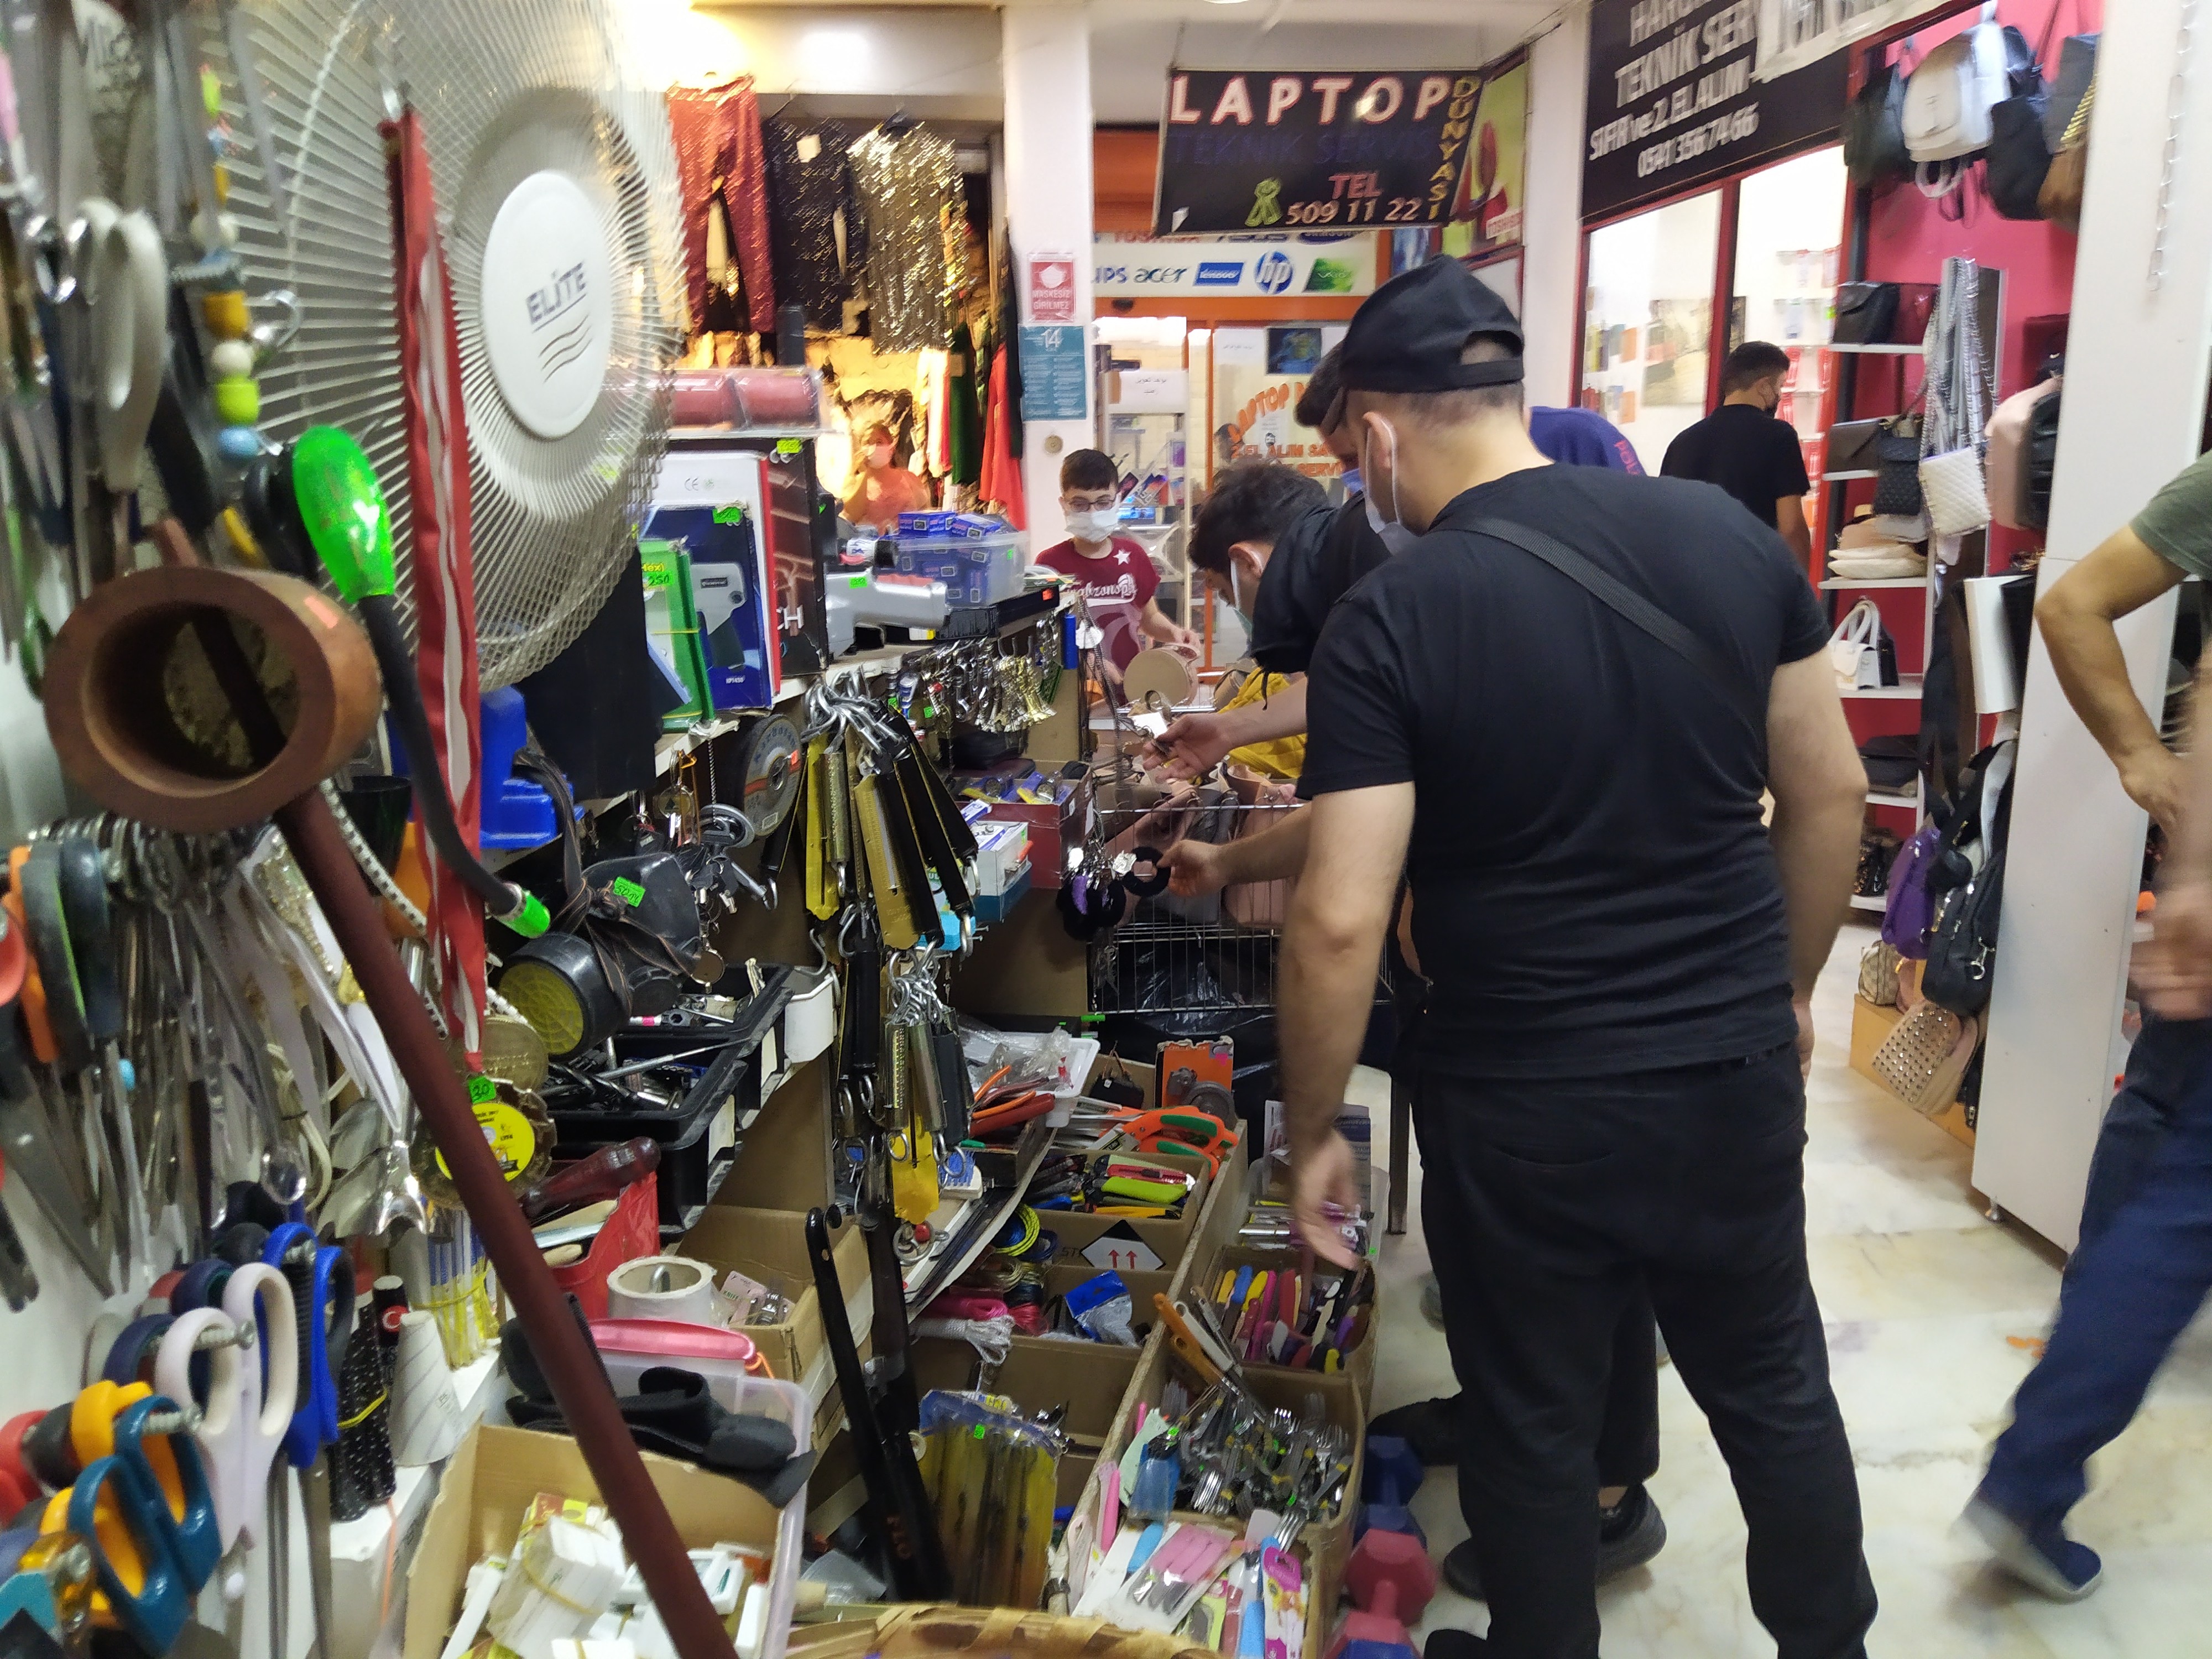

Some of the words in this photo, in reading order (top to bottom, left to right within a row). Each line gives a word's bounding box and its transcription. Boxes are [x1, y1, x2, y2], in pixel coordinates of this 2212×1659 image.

[1699, 0, 1757, 65] SER
[1168, 75, 1452, 125] LAPTOP
[1328, 171, 1382, 200] TEL
[1285, 199, 1338, 226] 509
[1347, 198, 1378, 222] 11
[1385, 197, 1424, 222] 22
[1132, 265, 1189, 284] acer
[1254, 250, 1294, 295] hp
[1227, 383, 1290, 444] LAPTOP
[1266, 444, 1304, 458] ALIM
